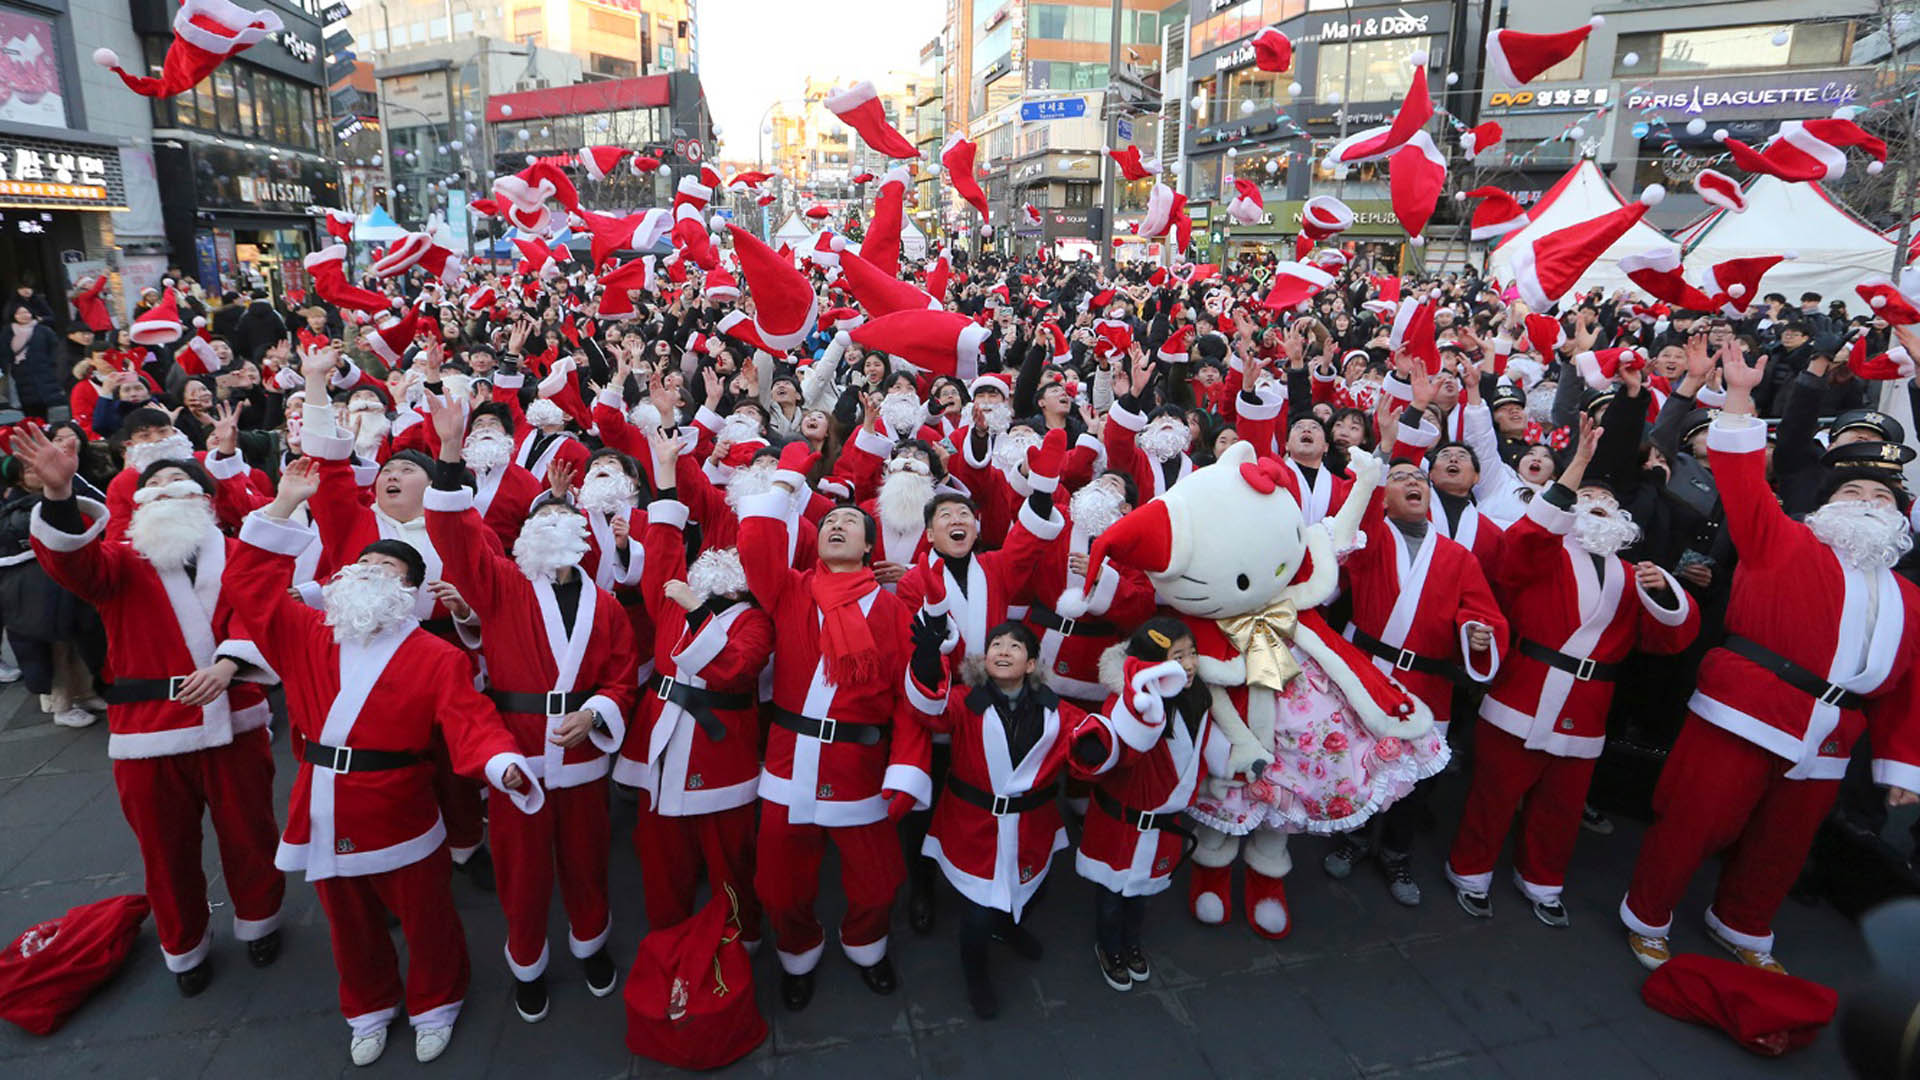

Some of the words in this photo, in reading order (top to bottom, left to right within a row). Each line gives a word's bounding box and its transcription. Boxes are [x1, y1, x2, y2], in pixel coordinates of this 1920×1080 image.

[1321, 19, 1362, 39] Mari
[1364, 18, 1378, 36] &
[1215, 52, 1233, 70] Mari
[1489, 91, 1534, 106] DVD
[1628, 92, 1688, 109] PARIS
[1703, 87, 1819, 106] BAGUETTE
[1821, 81, 1858, 105] Café
[1038, 102, 1065, 113] 연세로
[256, 181, 314, 203] MISSHA
